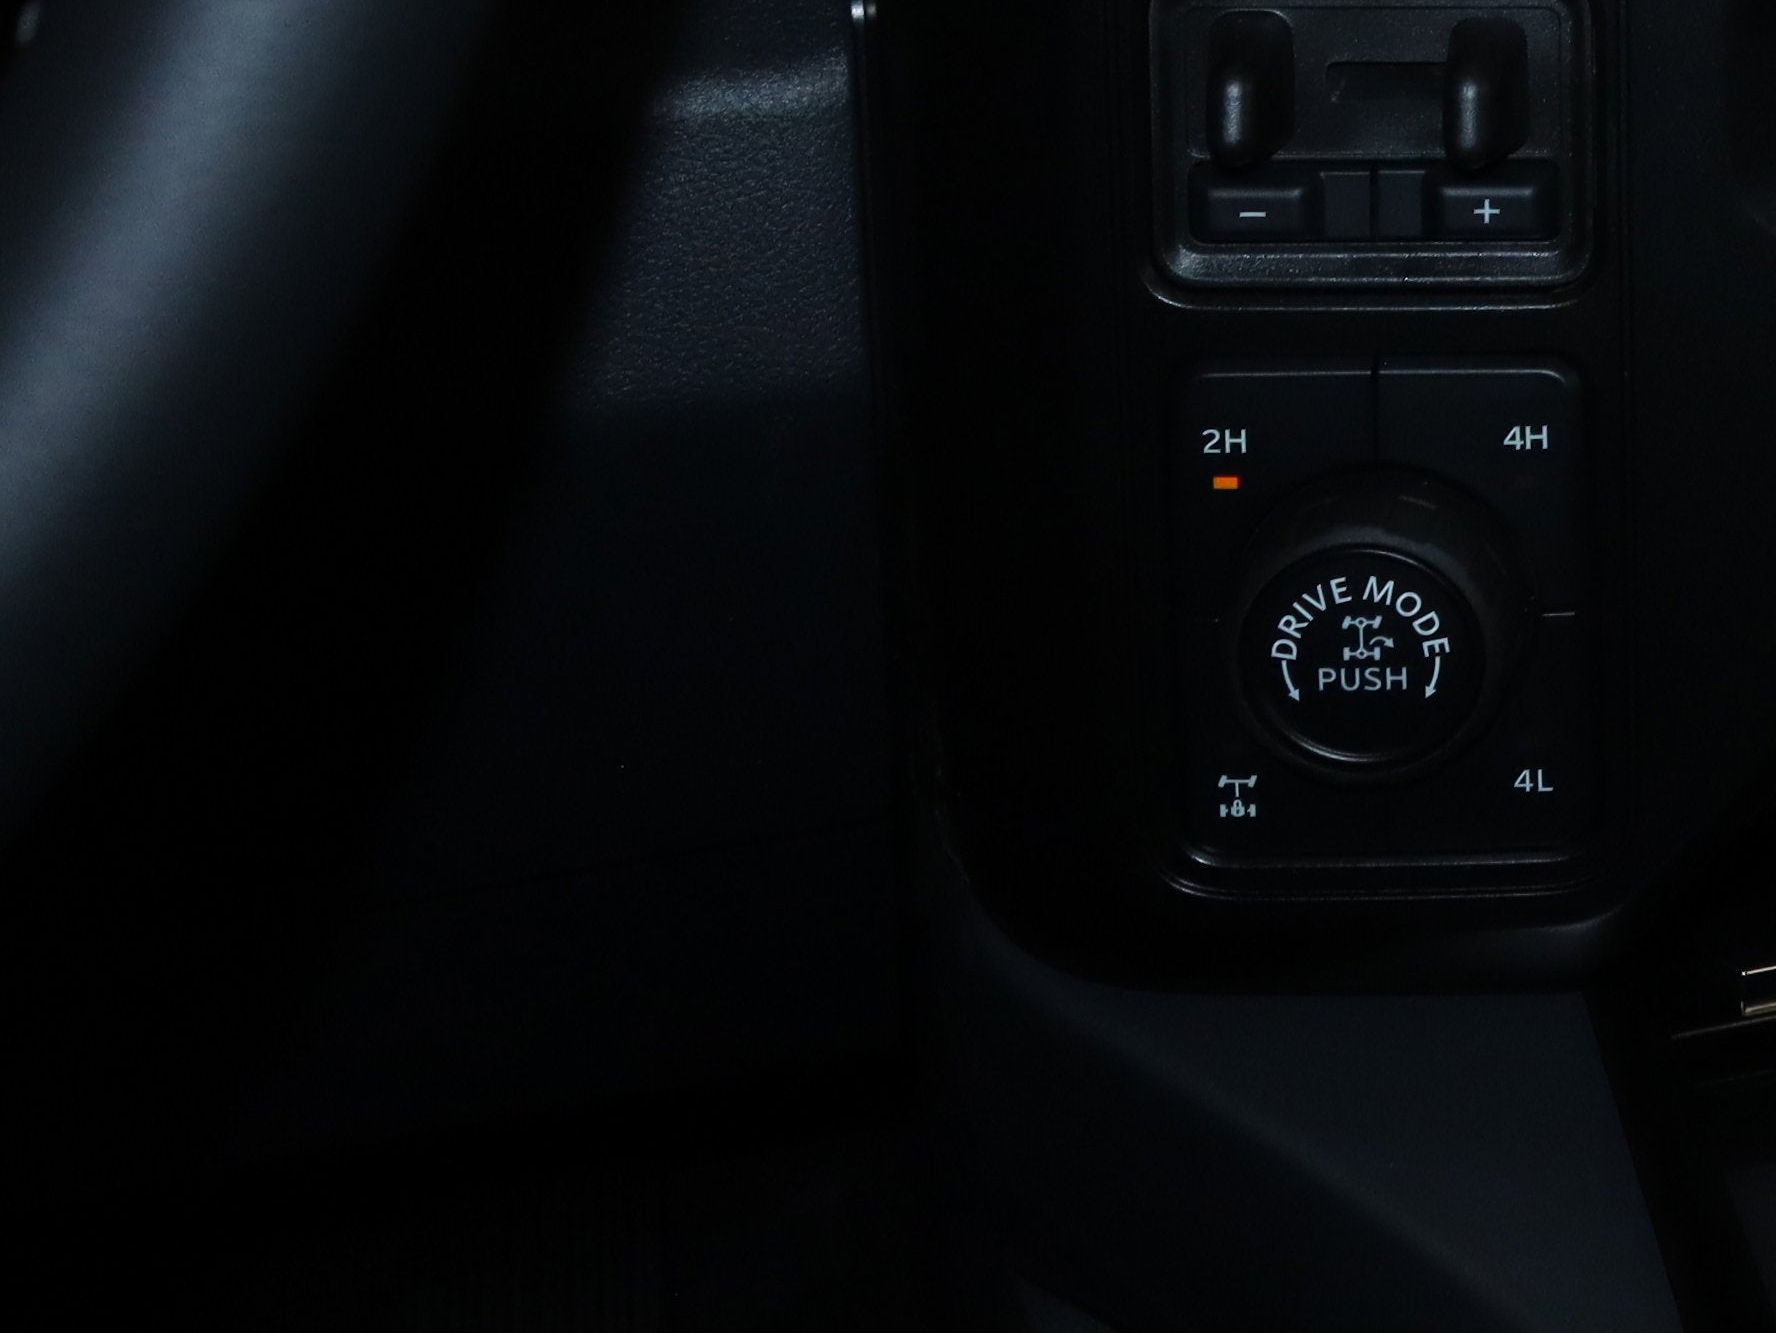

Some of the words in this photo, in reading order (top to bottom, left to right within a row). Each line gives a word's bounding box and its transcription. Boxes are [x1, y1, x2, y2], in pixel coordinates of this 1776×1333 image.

[1202, 428, 1248, 455] 2H
[1502, 424, 1550, 451] 4H
[1271, 576, 1353, 661] DRIVE
[1363, 575, 1451, 658] MODE
[1317, 667, 1408, 692] PUSH
[1513, 769, 1554, 793] 4L
